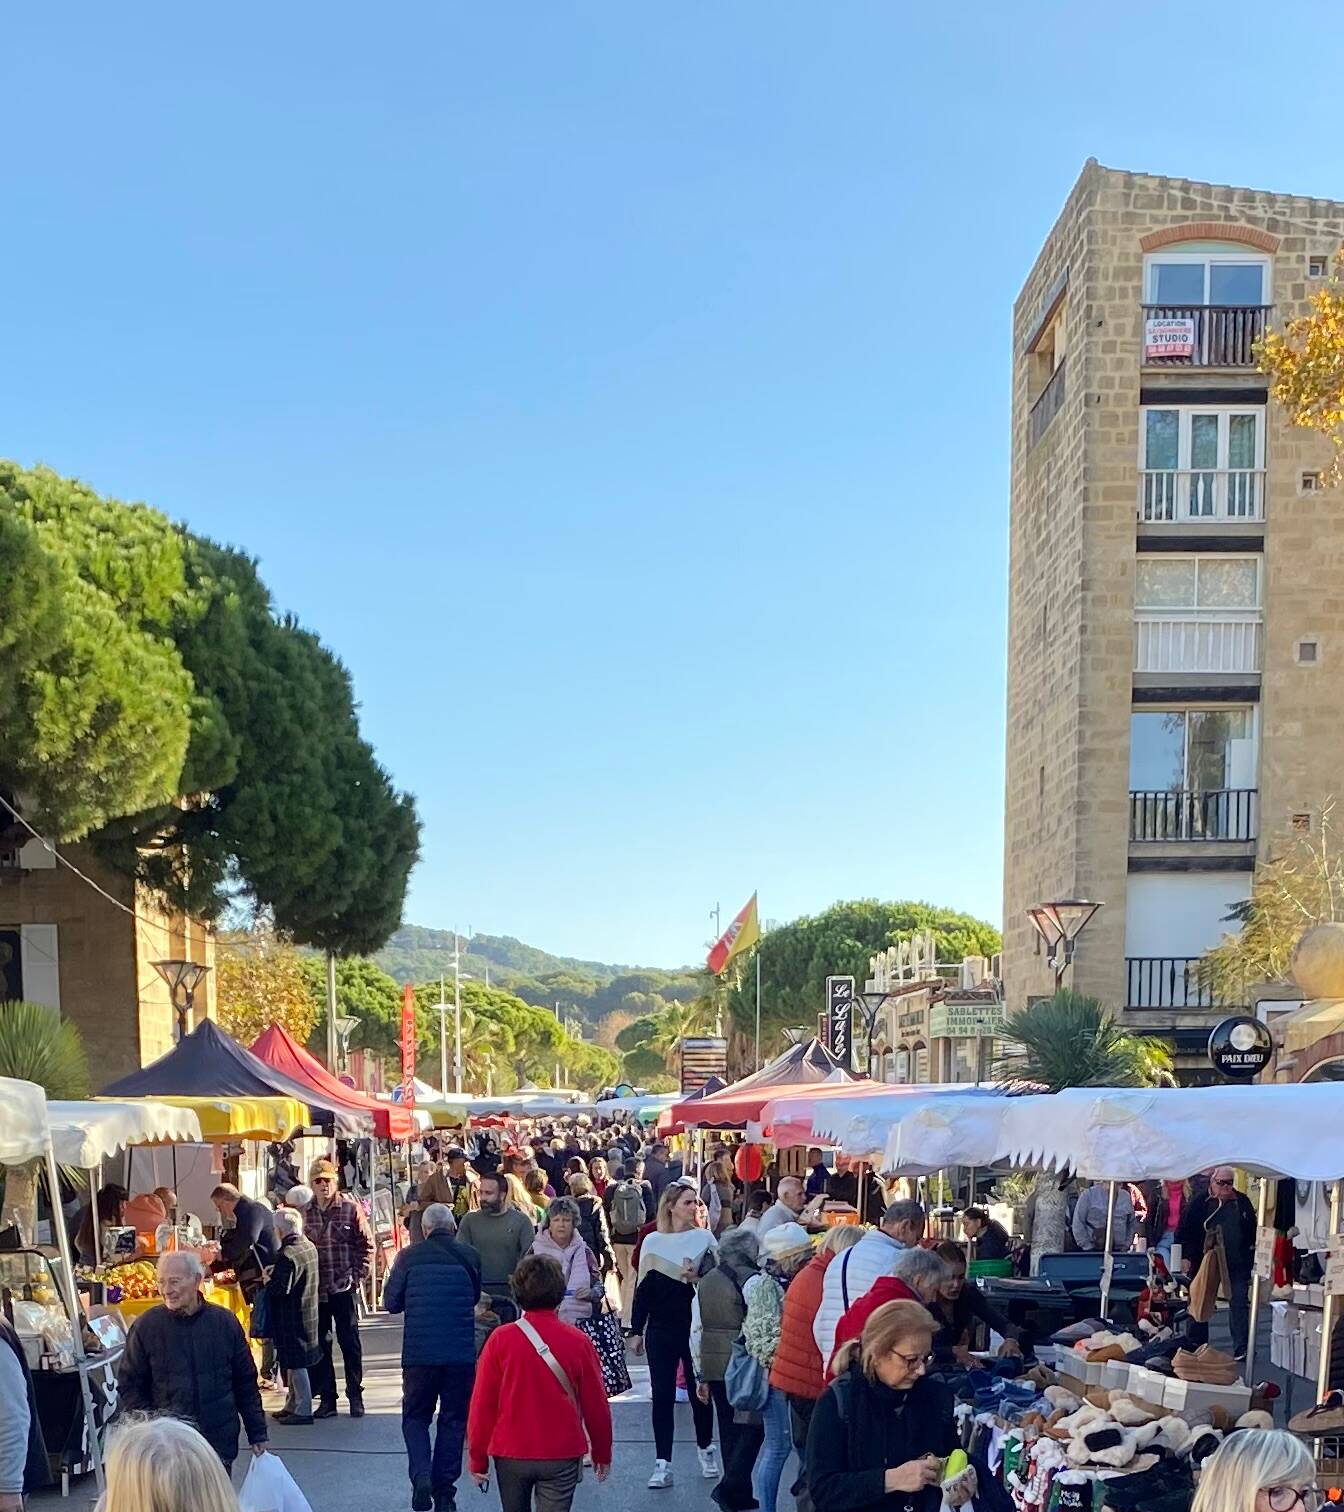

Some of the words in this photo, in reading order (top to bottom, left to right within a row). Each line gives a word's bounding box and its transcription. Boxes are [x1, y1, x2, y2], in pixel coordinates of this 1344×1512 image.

[1152, 334, 1189, 343] STUDIO
[833, 983, 851, 998] Le
[947, 1007, 1003, 1016] SABLETTES
[1221, 1054, 1243, 1064] PAIX
